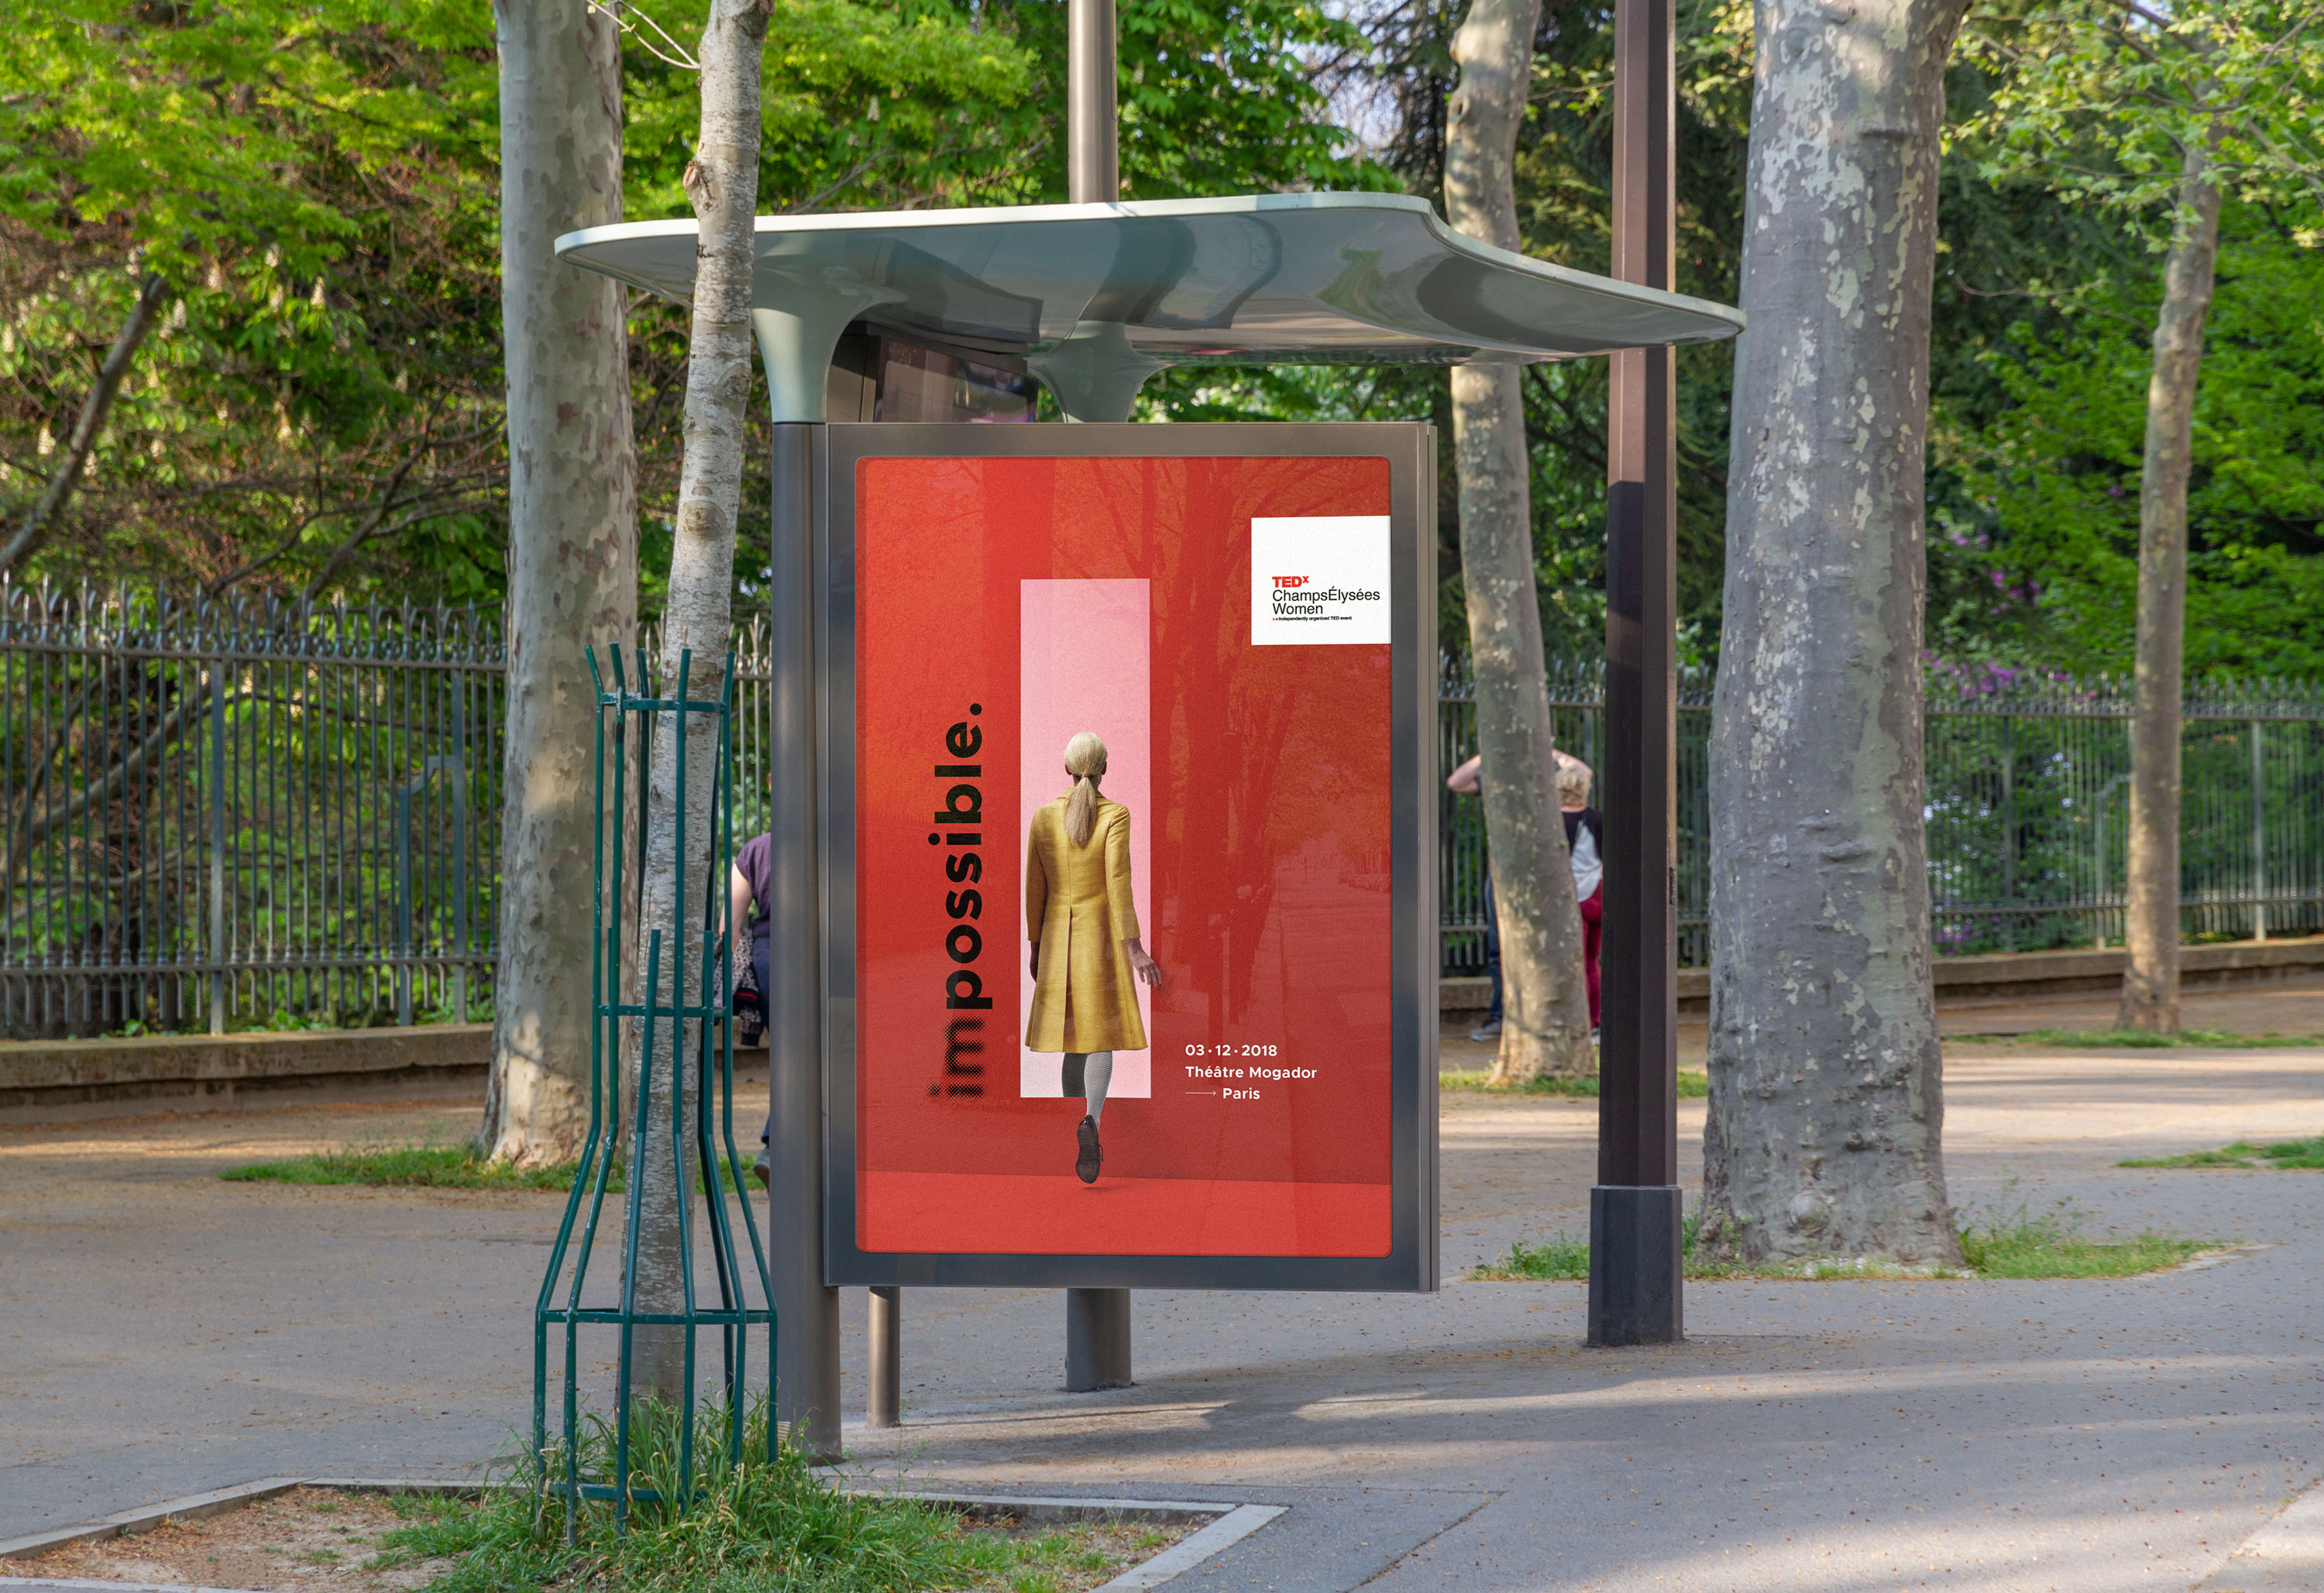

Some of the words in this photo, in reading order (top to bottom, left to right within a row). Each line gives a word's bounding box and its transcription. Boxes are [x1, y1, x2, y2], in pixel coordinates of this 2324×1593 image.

[1272, 586, 1380, 604] ChampsÉlysées
[1272, 603, 1323, 615] Women
[928, 703, 993, 1100] impossible.
[1185, 1066, 1244, 1078] Théâtre
[1249, 1066, 1318, 1081] Mogador
[1222, 1087, 1260, 1100] Paris
